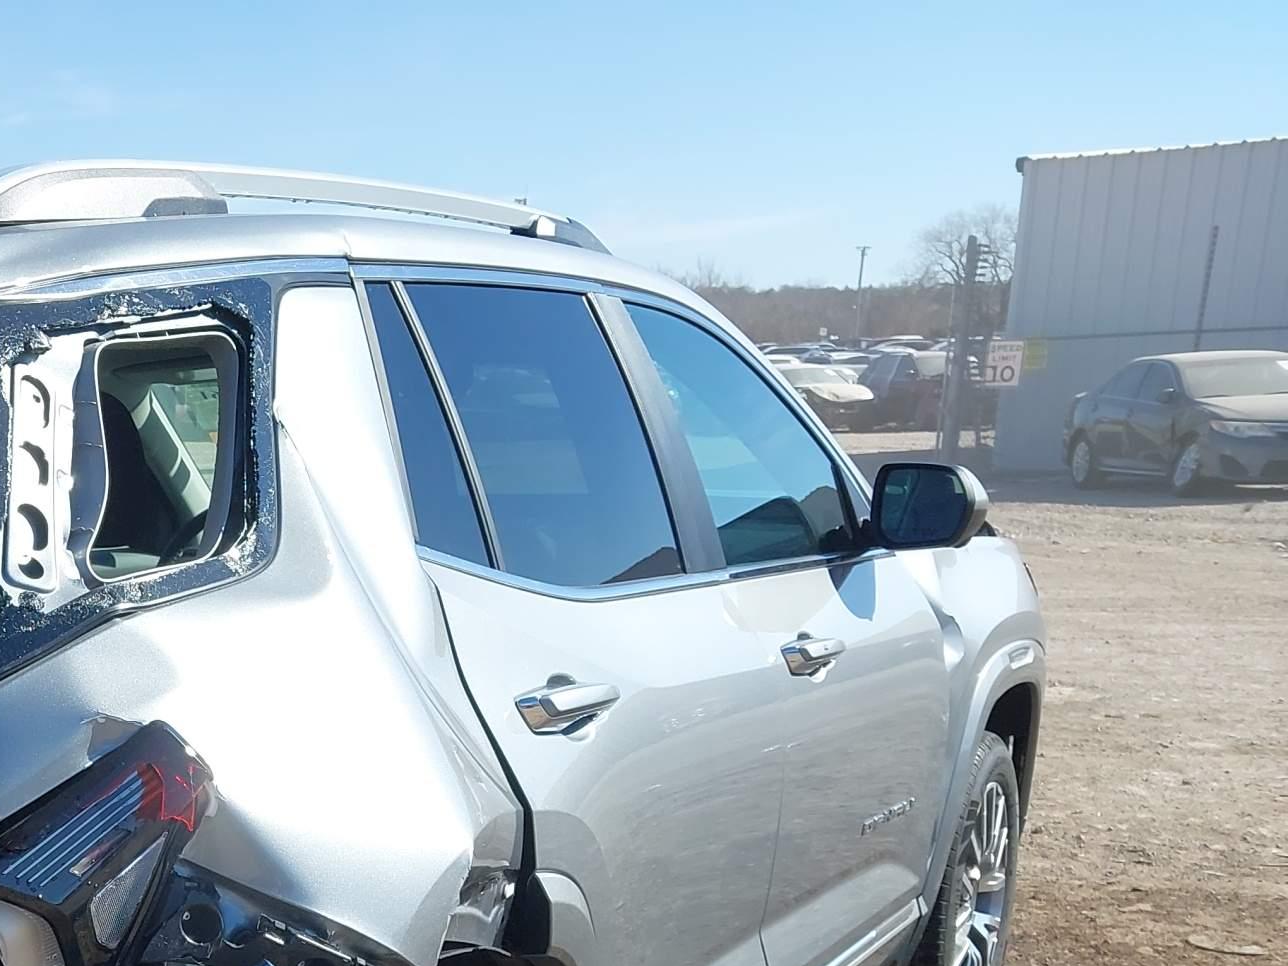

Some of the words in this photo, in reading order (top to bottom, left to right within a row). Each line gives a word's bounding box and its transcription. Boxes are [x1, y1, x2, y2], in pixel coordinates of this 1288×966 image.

[990, 343, 1024, 353] SPEED
[992, 354, 1018, 362] LIMIT
[988, 364, 1016, 384] 10
